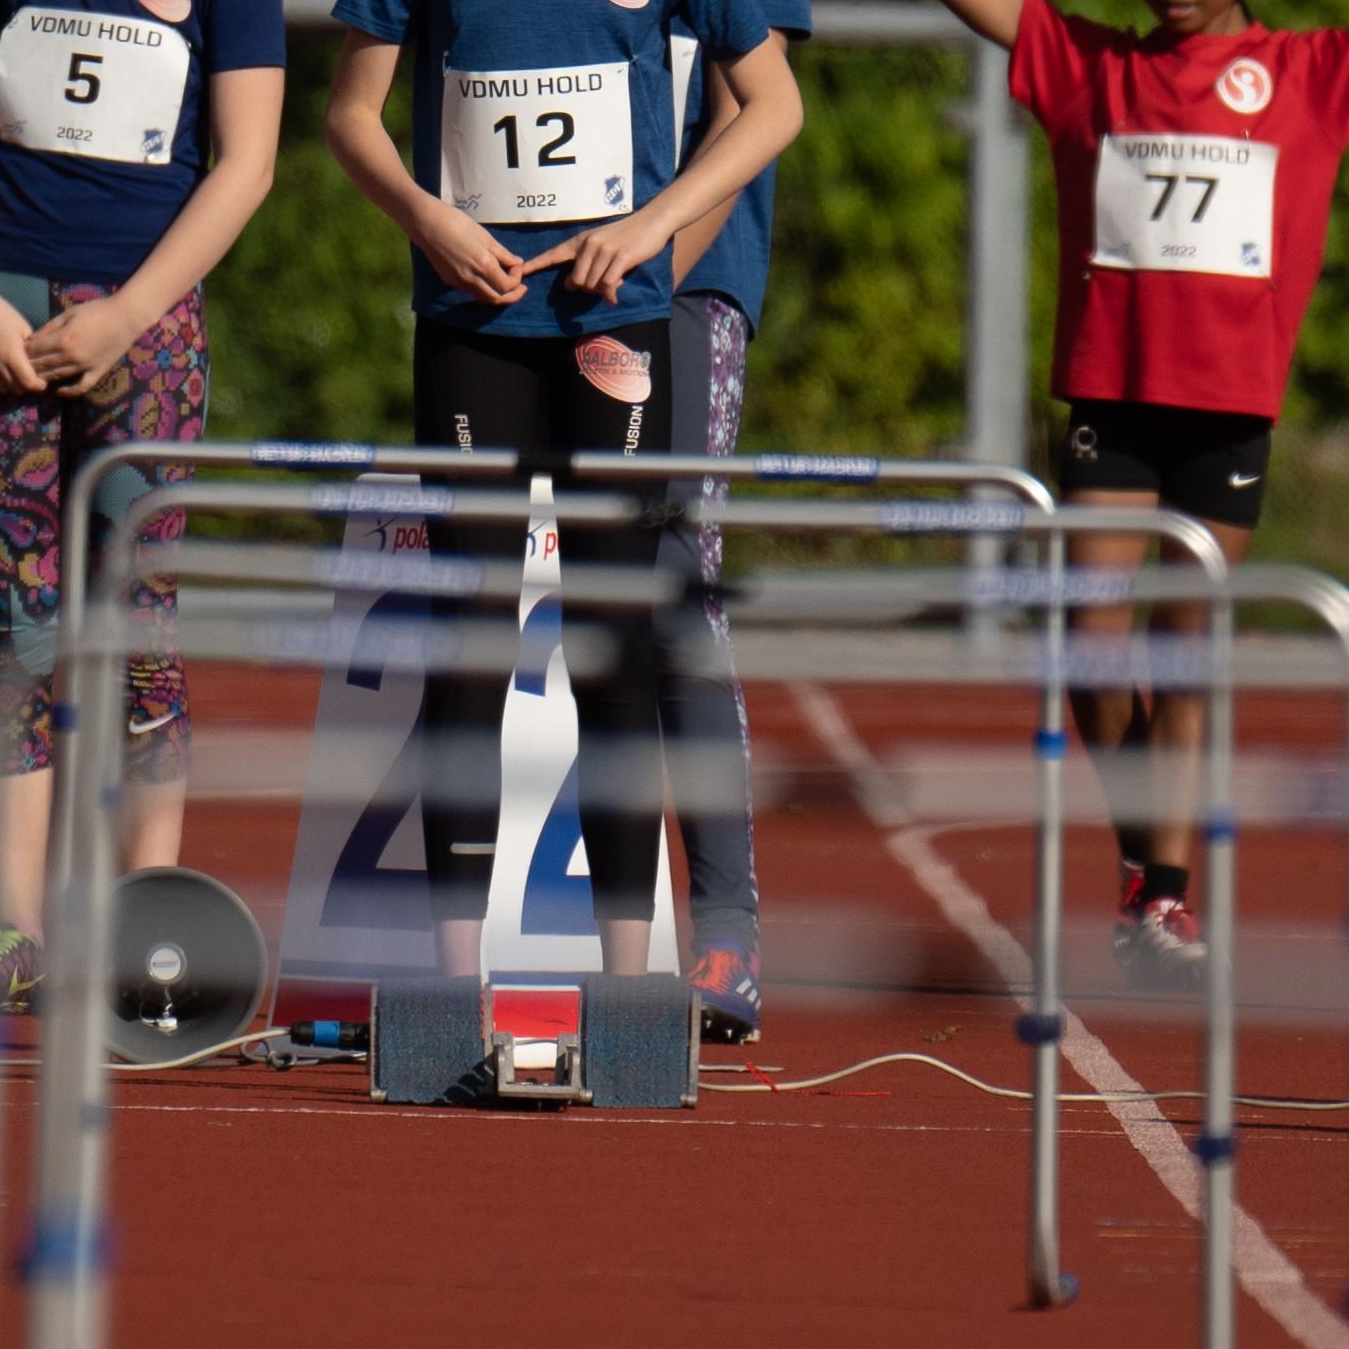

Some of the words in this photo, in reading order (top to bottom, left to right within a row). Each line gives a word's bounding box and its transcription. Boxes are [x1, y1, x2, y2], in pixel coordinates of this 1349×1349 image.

[30, 15, 92, 38] VDMU
[97, 21, 163, 48] HOLD
[64, 52, 104, 105] 5
[458, 78, 529, 99] VDMU
[536, 73, 603, 97] HOLD
[56, 126, 93, 142] 2022
[493, 111, 577, 170] 12
[1124, 141, 1185, 160] VDMU
[1191, 144, 1250, 165] HOLD
[516, 193, 558, 209] 2022
[1143, 173, 1221, 224] 77
[1160, 244, 1197, 258] 2022
[623, 405, 644, 457] FUSION
